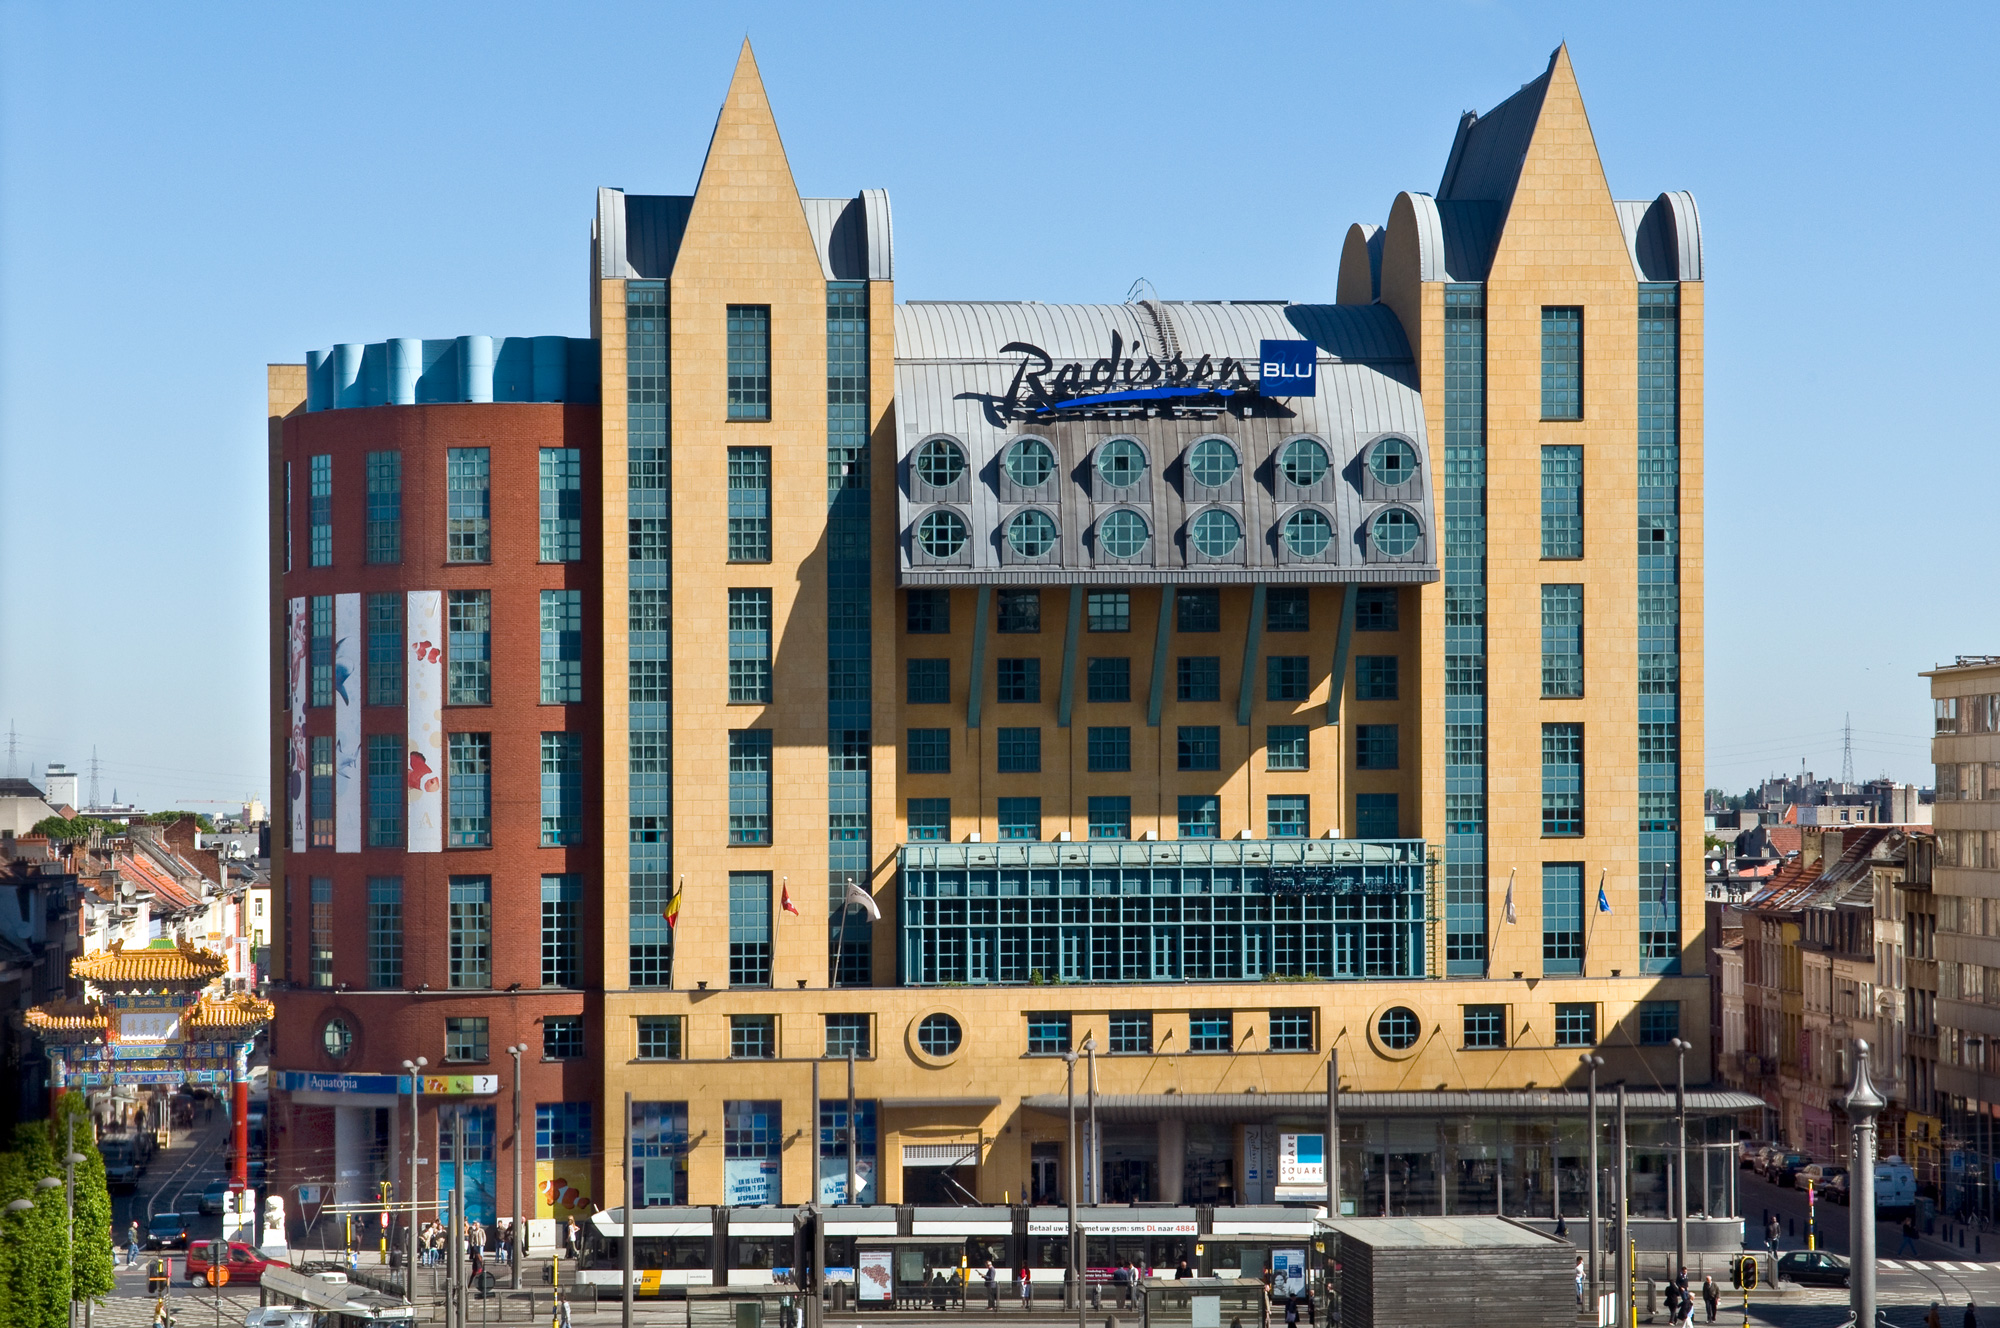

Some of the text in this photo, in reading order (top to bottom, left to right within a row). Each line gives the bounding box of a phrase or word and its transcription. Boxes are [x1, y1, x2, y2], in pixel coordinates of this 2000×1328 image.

[1000, 329, 1312, 415] Radisson BLU
[311, 1075, 358, 1092] Aquatopia
[1282, 1167, 1323, 1175] SQUARE
[1029, 1224, 1052, 1232] Betaal
